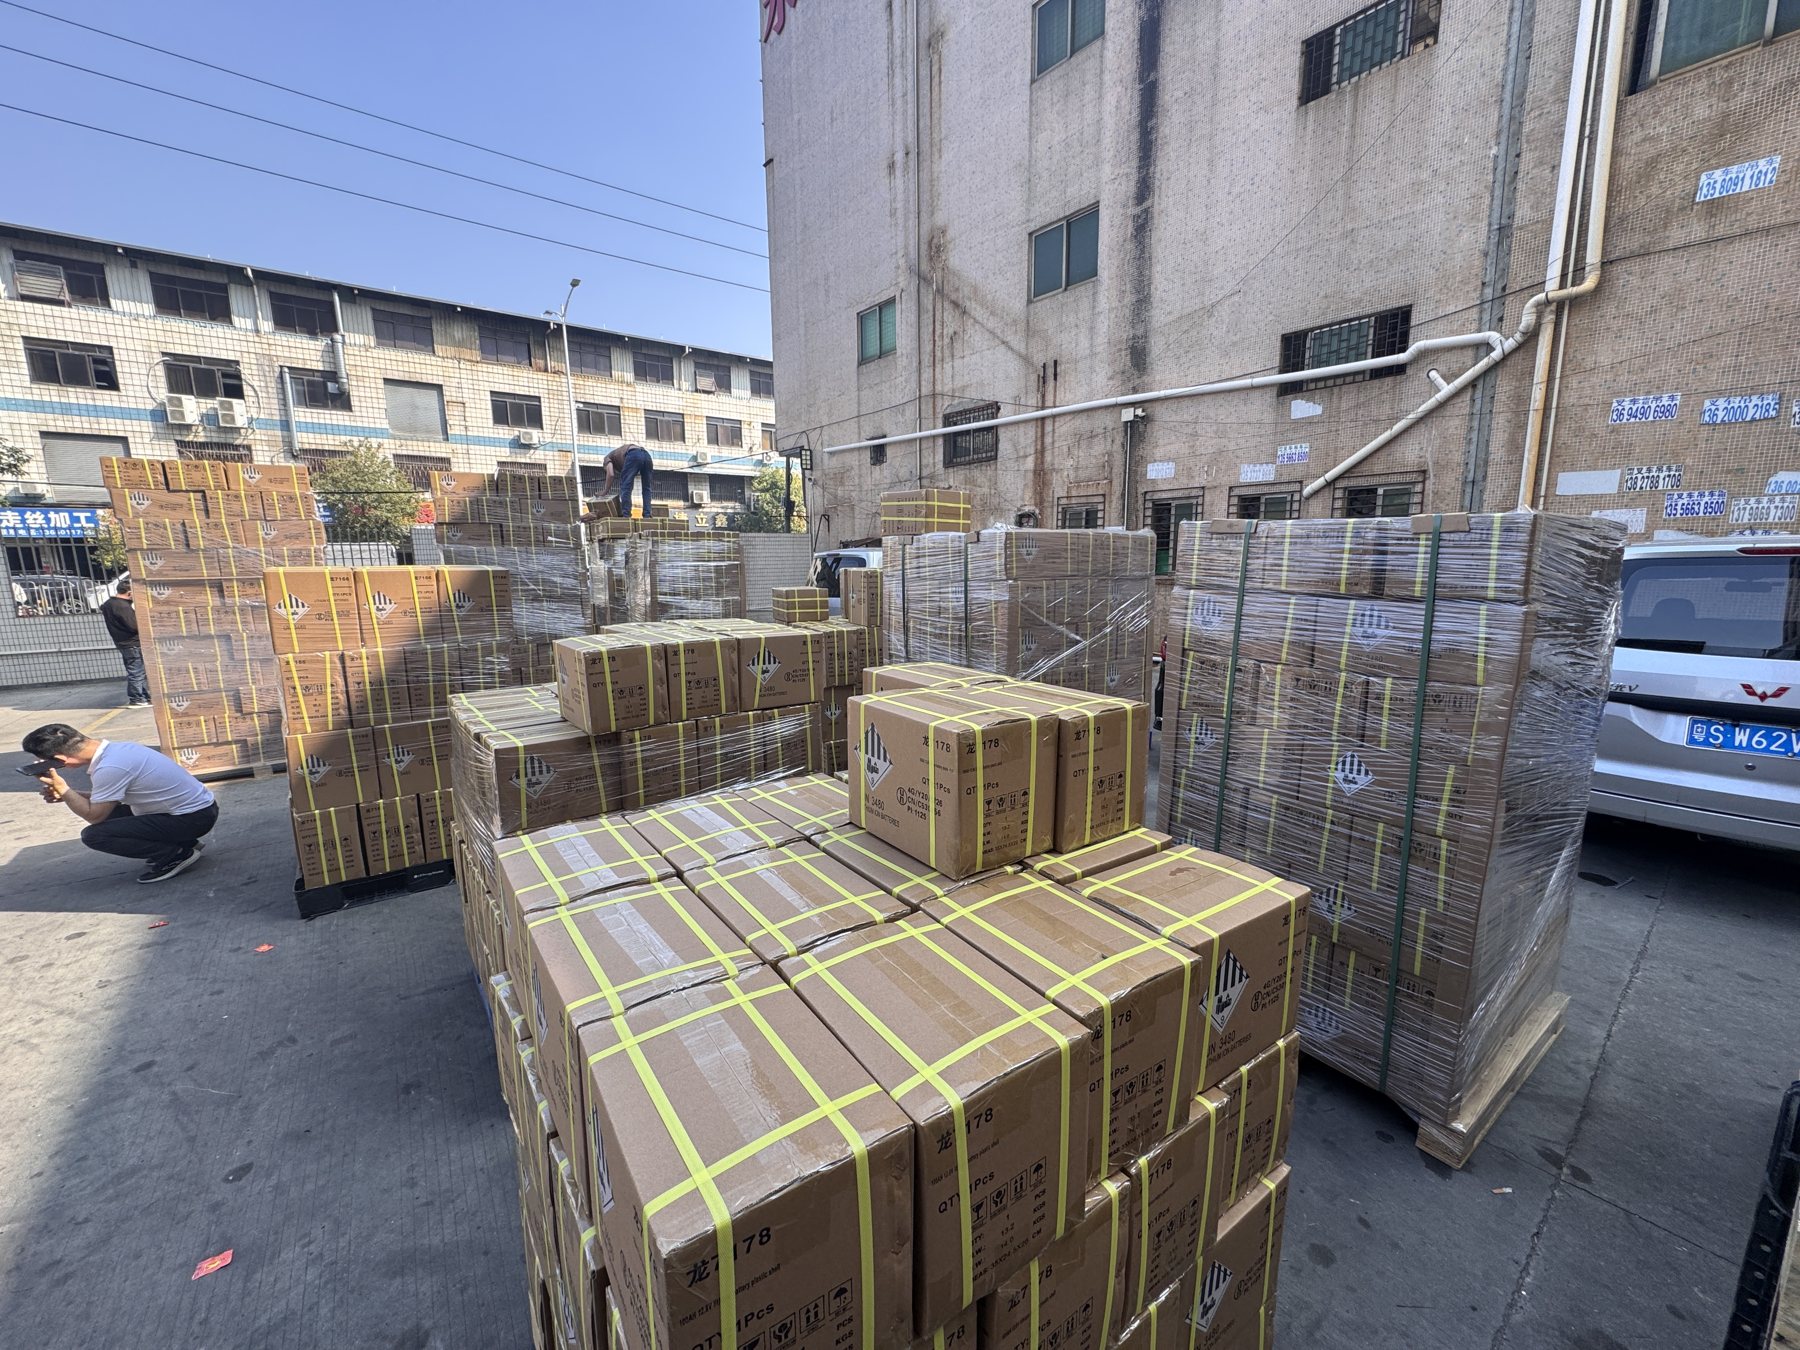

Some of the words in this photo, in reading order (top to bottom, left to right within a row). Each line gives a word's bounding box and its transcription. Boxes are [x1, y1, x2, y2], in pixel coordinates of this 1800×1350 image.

[1698, 179, 1718, 200] 135
[1719, 174, 1746, 196] 8091
[1748, 166, 1777, 189] 1812
[1610, 407, 1625, 422] 136
[1626, 405, 1650, 421] 9490
[1652, 403, 1678, 420] 6980
[1702, 408, 1718, 424] 136
[1721, 406, 1749, 423] 2000
[1751, 402, 1779, 420] 2185
[1625, 476, 1637, 491] 138
[1639, 475, 1660, 490] 2788
[1661, 473, 1682, 489] 1708
[1766, 480, 1784, 493] 136
[1665, 503, 1678, 517] 135
[1679, 502, 1701, 517] 5663
[1702, 501, 1725, 515] 8500
[1731, 506, 1747, 522] 137
[1747, 505, 1771, 522] 9869
[1772, 504, 1796, 521] 7300
[922, 734, 951, 753] 龙178
[966, 738, 1000, 755] 龙178
[1091, 1009, 1133, 1042] 龙178
[936, 1107, 994, 1154] 龙178
